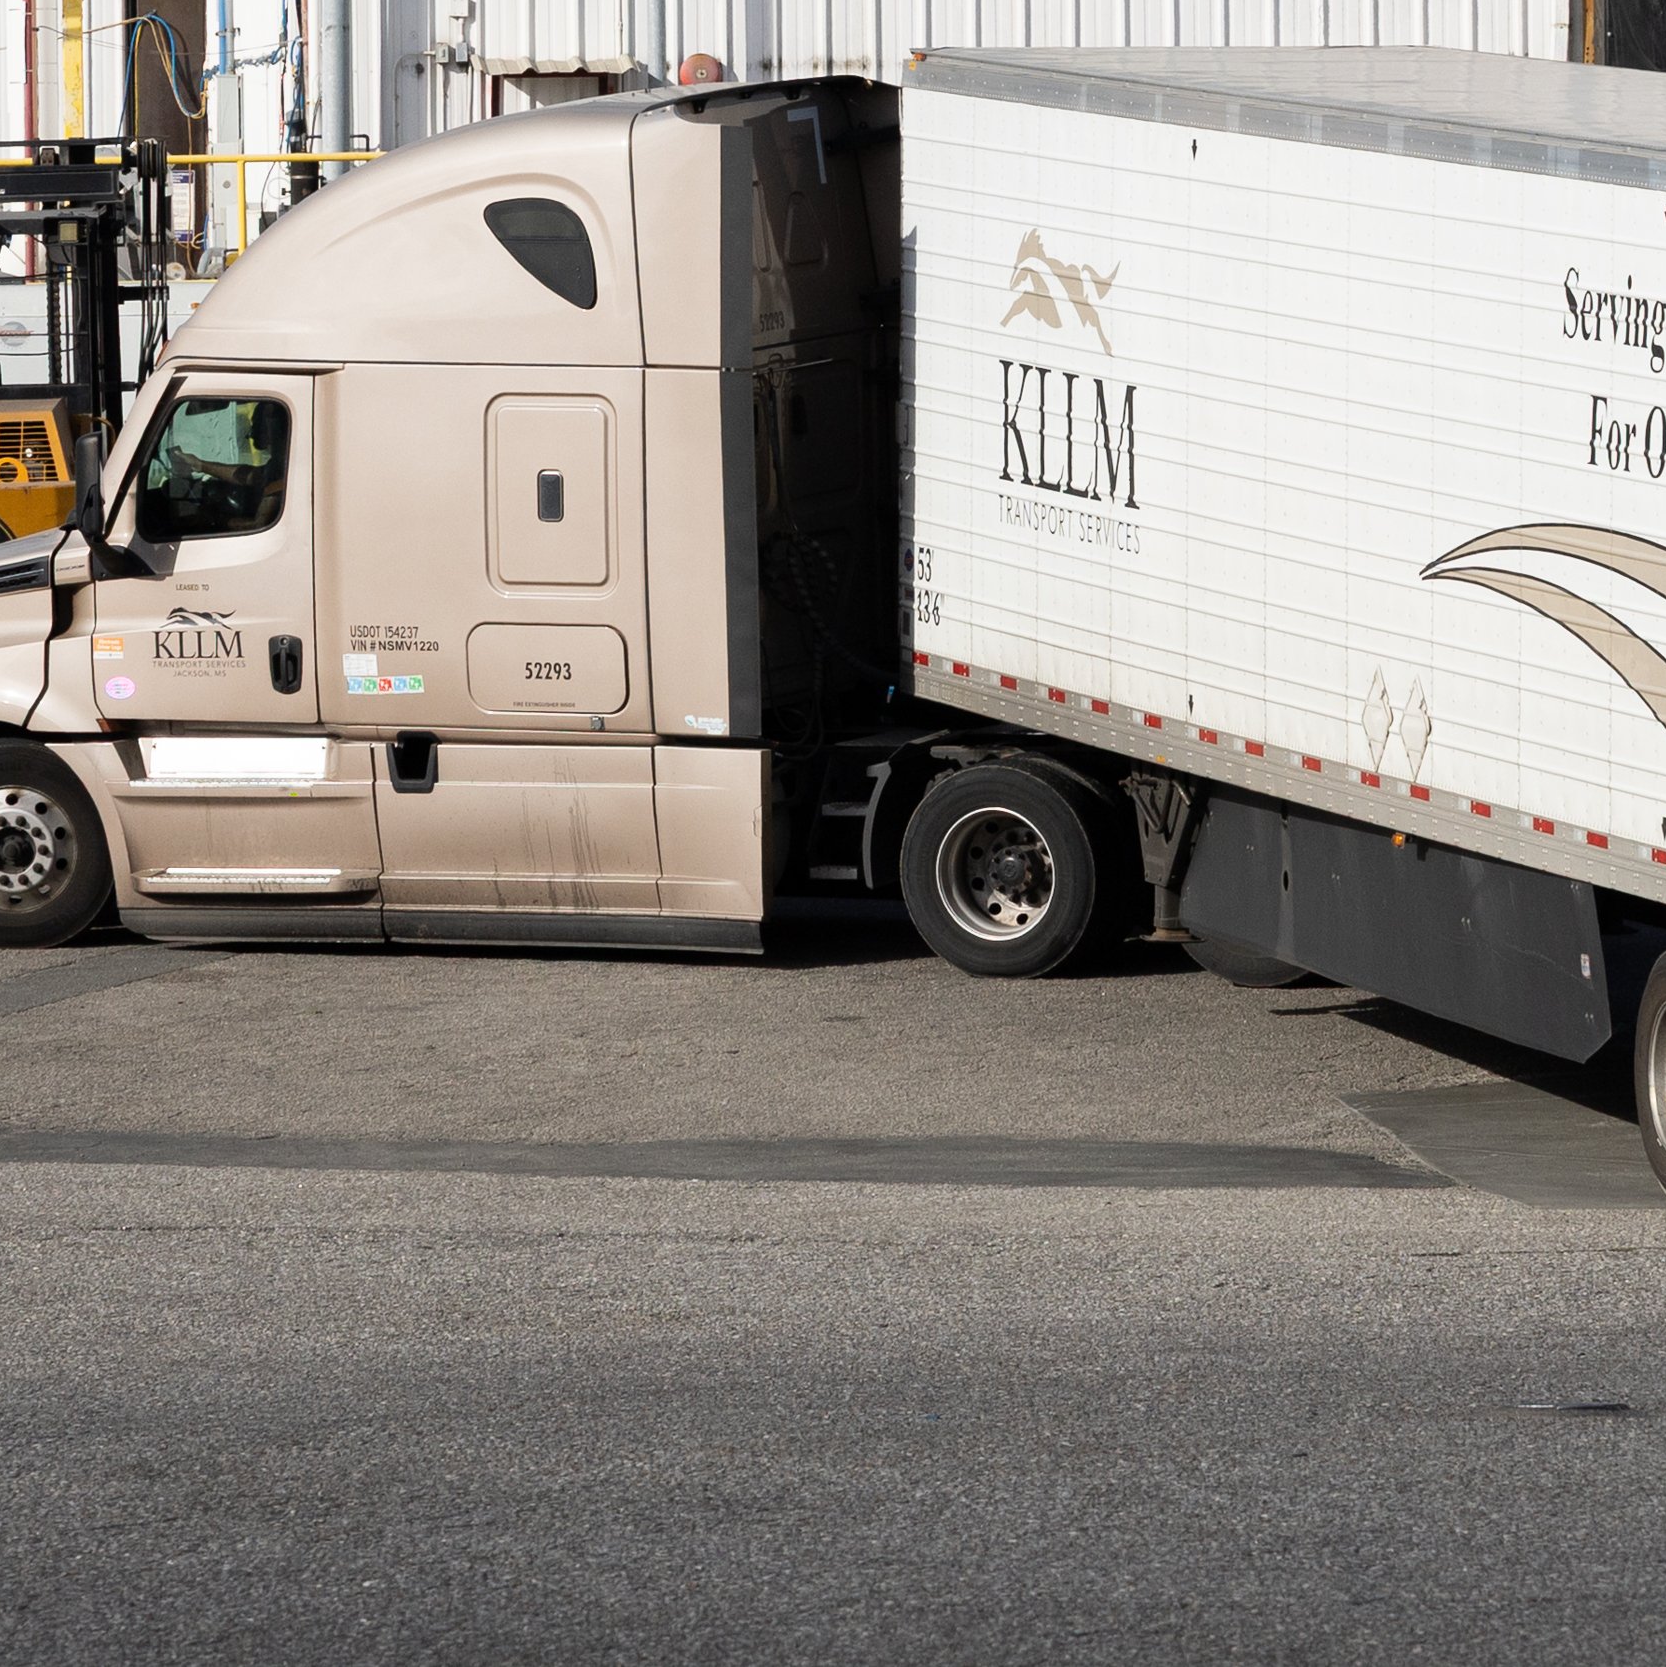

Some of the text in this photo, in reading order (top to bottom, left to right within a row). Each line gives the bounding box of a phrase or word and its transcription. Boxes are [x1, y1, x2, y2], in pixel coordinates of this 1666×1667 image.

[1563, 267, 1666, 373] Serving
[999, 359, 1140, 510] KLLM
[1587, 394, 1636, 473] For
[999, 494, 1141, 555] TRANSPORT SERVICES
[350, 625, 419, 639] USDOT 154237
[152, 630, 245, 659] KLLM
[350, 640, 367, 651] VIN
[152, 660, 247, 668] TRANSPORT SERVICES
[214, 669, 227, 677] MS
[525, 662, 572, 680] 52293
